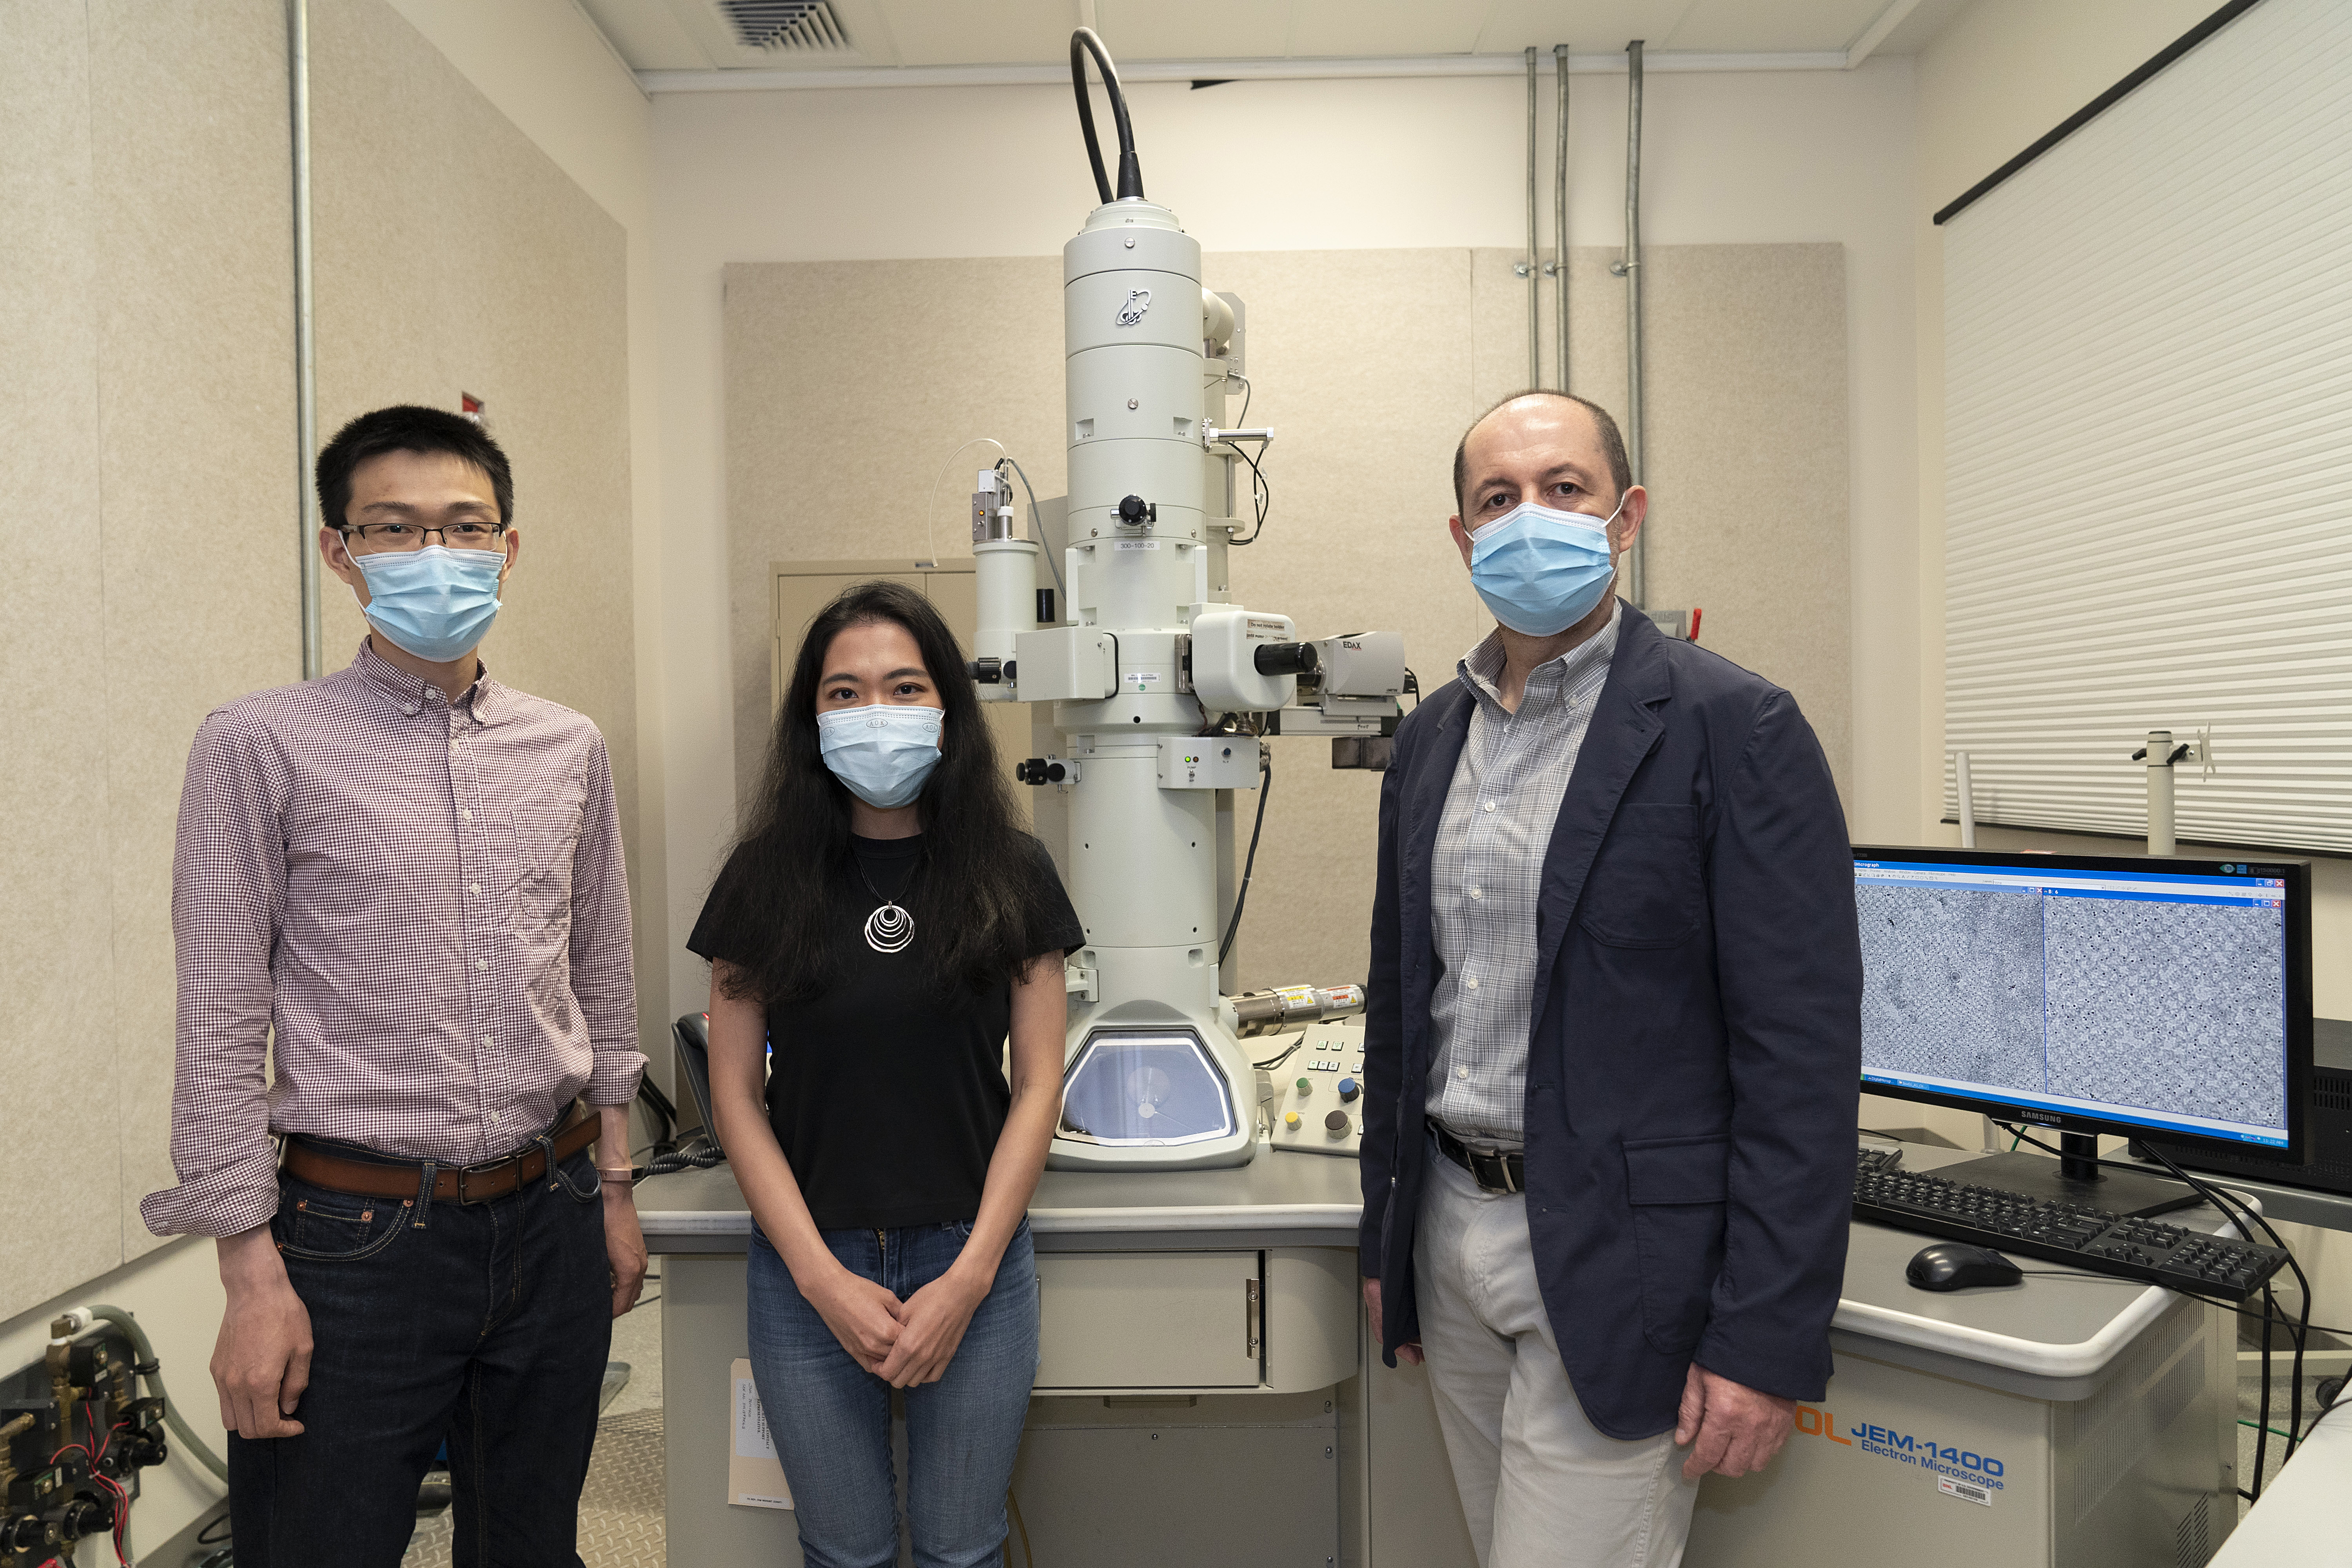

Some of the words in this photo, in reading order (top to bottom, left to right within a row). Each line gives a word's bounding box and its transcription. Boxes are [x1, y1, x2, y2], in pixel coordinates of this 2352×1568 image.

[1343, 641, 1361, 649] EDAX
[2021, 1111, 2062, 1123] SAMSUNG
[1795, 1405, 1852, 1446] OL
[1851, 1423, 2004, 1477] JEM-1400
[1862, 1439, 1916, 1465] Electron
[1921, 1456, 2004, 1490] Microscope
